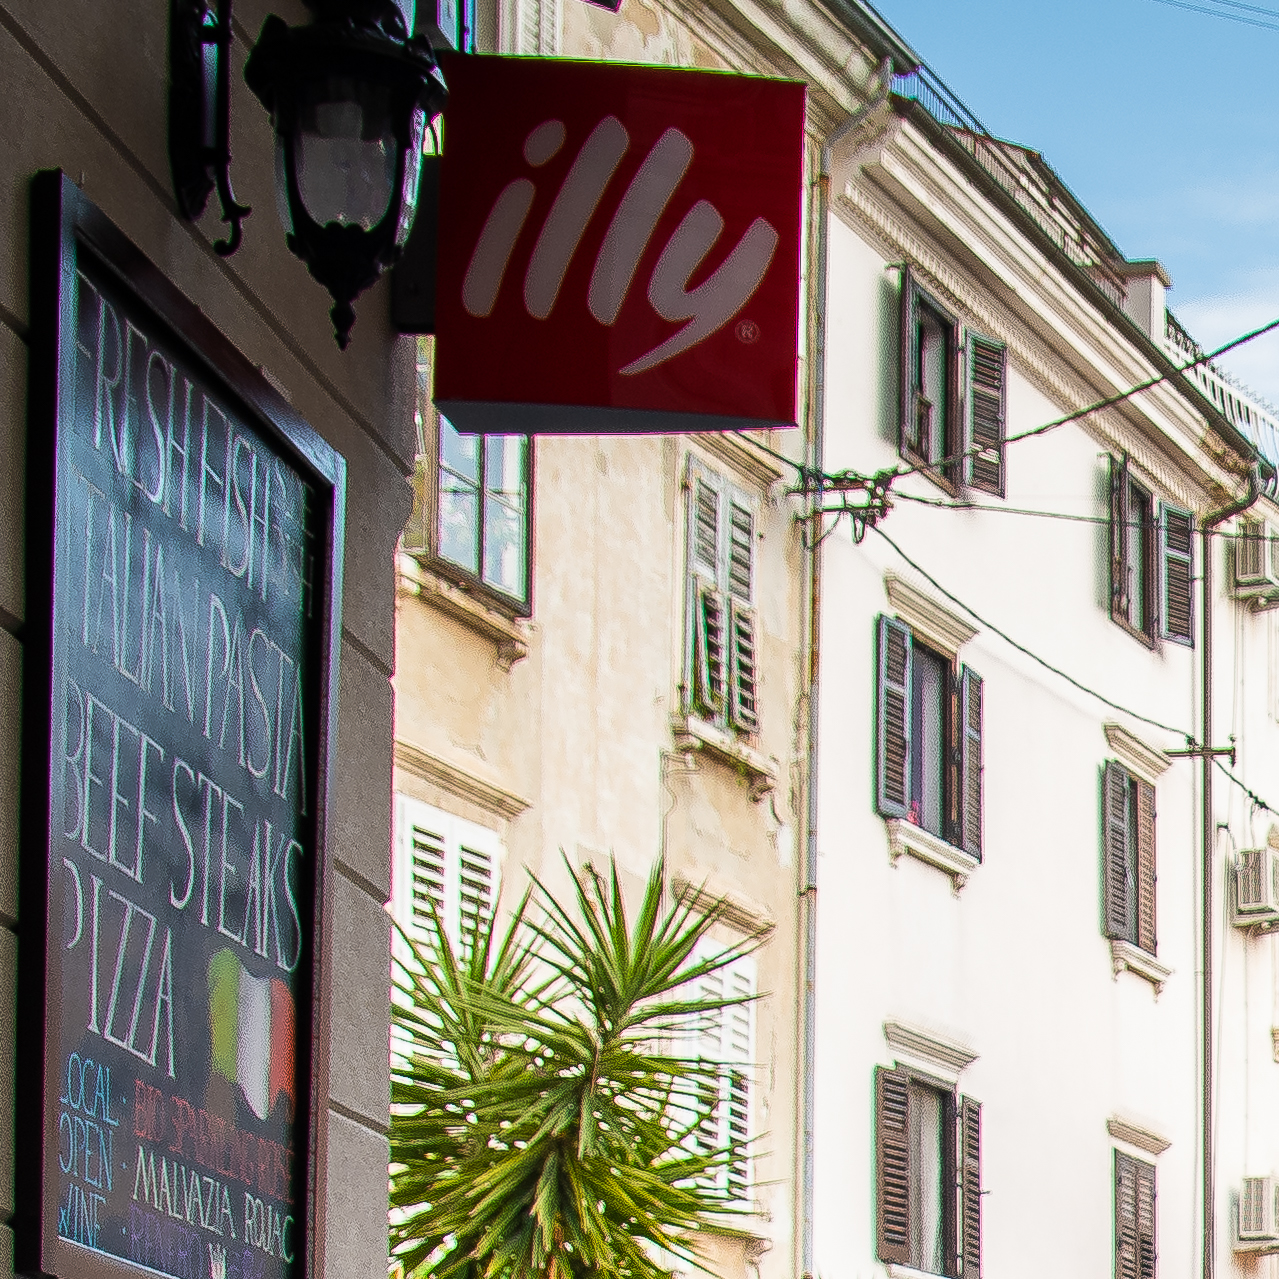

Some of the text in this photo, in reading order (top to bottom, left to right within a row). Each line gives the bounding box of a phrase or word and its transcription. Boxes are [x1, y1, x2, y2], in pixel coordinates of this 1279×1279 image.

[461, 114, 780, 376] illy
[196, 393, 270, 602] FISH
[63, 674, 303, 973] BEEF STEAKS
[202, 593, 306, 817] PASTA
